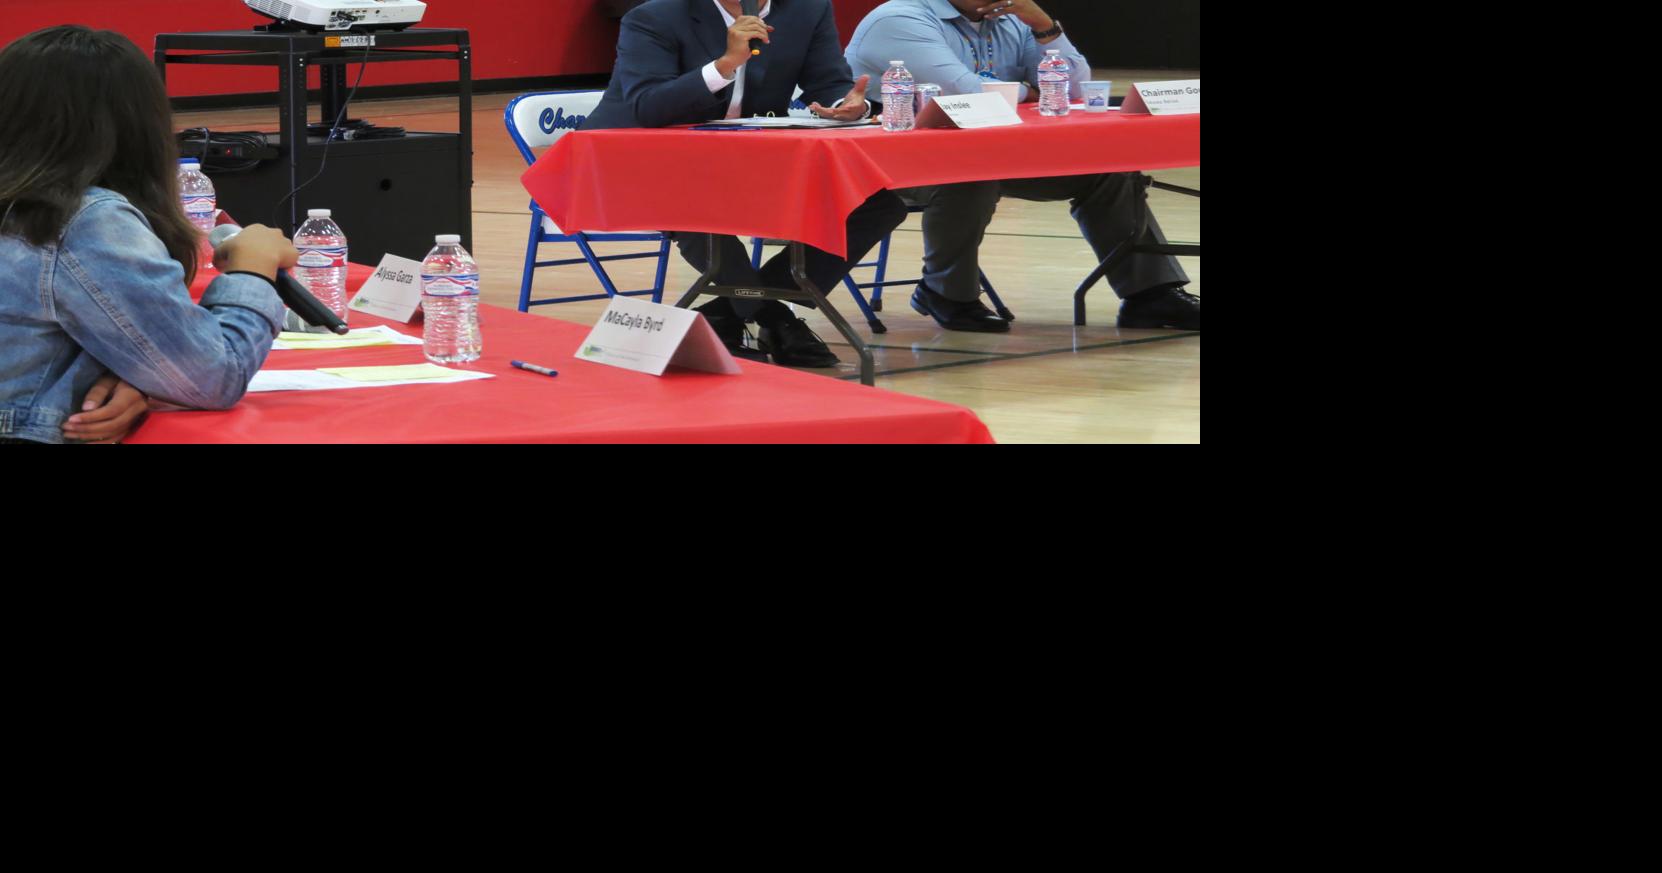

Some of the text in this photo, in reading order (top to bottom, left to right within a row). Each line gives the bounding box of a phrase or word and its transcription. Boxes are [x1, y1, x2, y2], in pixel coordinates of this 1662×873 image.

[1141, 88, 1184, 97] Chairman
[374, 266, 414, 284] Alyssa Garza
[603, 309, 665, 333] MaCayla Byrd
